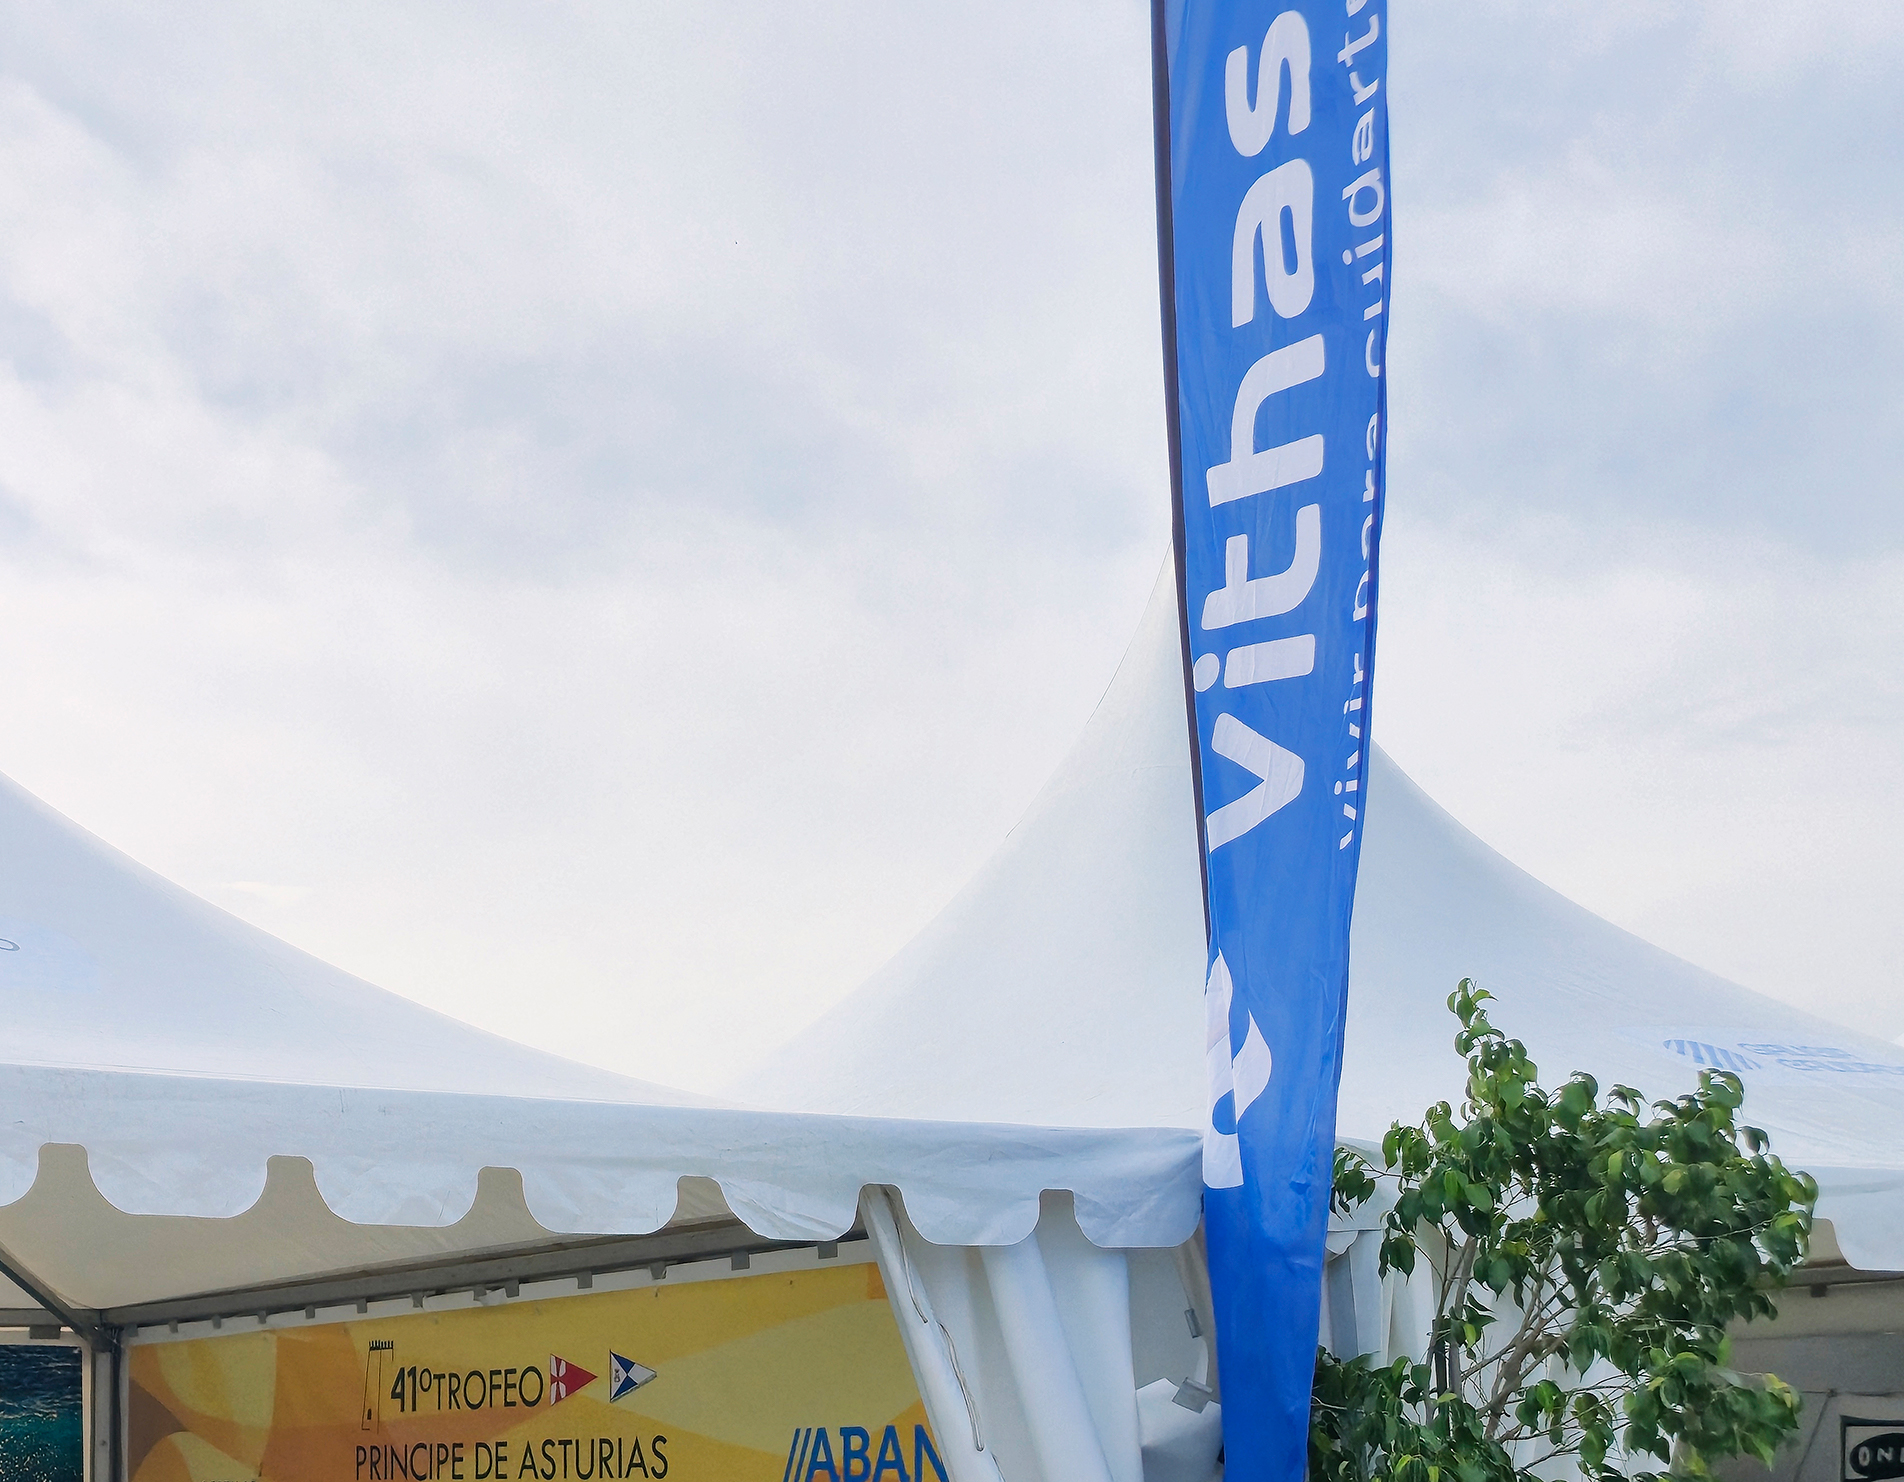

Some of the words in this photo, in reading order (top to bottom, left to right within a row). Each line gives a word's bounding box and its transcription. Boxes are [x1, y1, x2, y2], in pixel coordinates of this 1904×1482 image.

[1192, 9, 1326, 853] vithas
[355, 1442, 465, 1482] PRINCIPE
[475, 1440, 508, 1481] DE
[517, 1434, 670, 1481] ASTURIAS
